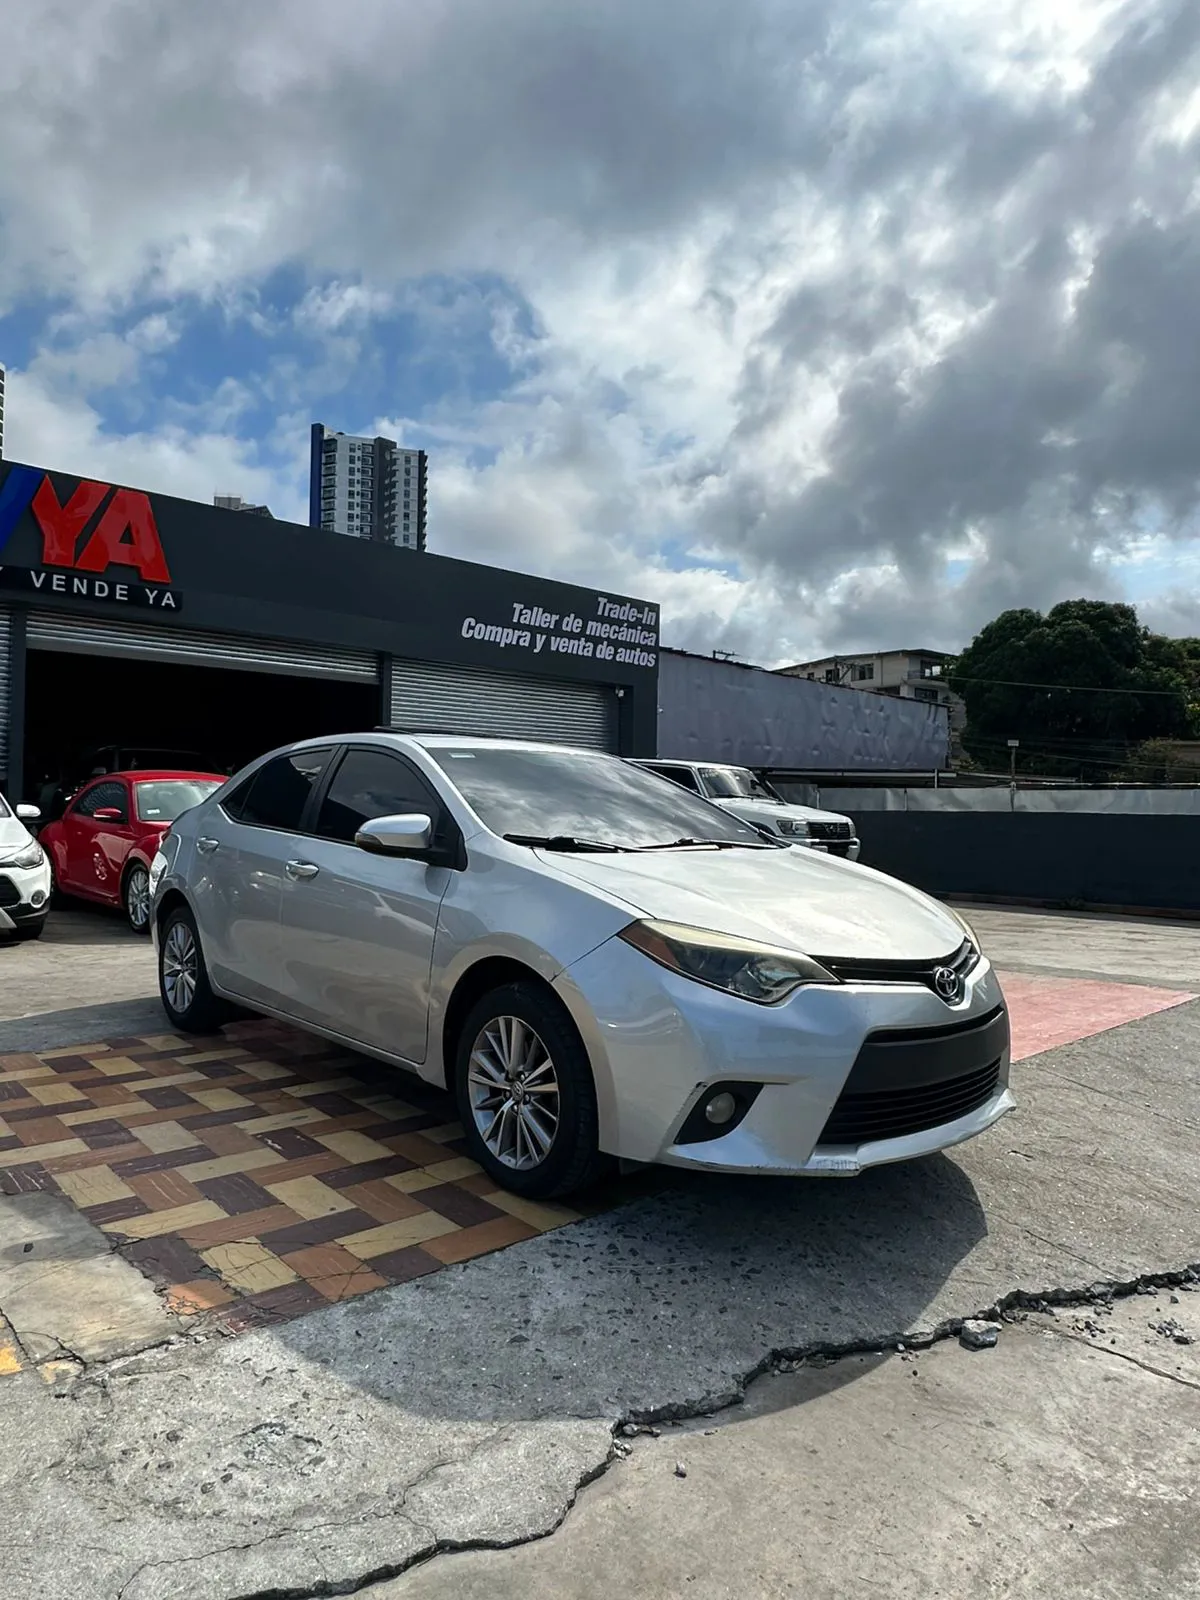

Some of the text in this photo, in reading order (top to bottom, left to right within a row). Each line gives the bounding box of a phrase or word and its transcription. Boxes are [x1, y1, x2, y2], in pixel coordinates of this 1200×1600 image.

[31, 473, 172, 584] YA
[30, 570, 176, 608] VENDE YA
[597, 596, 657, 626] Trade-In
[461, 617, 657, 667] Compra y venta de autos
[512, 602, 657, 647] Taller de mecánica
